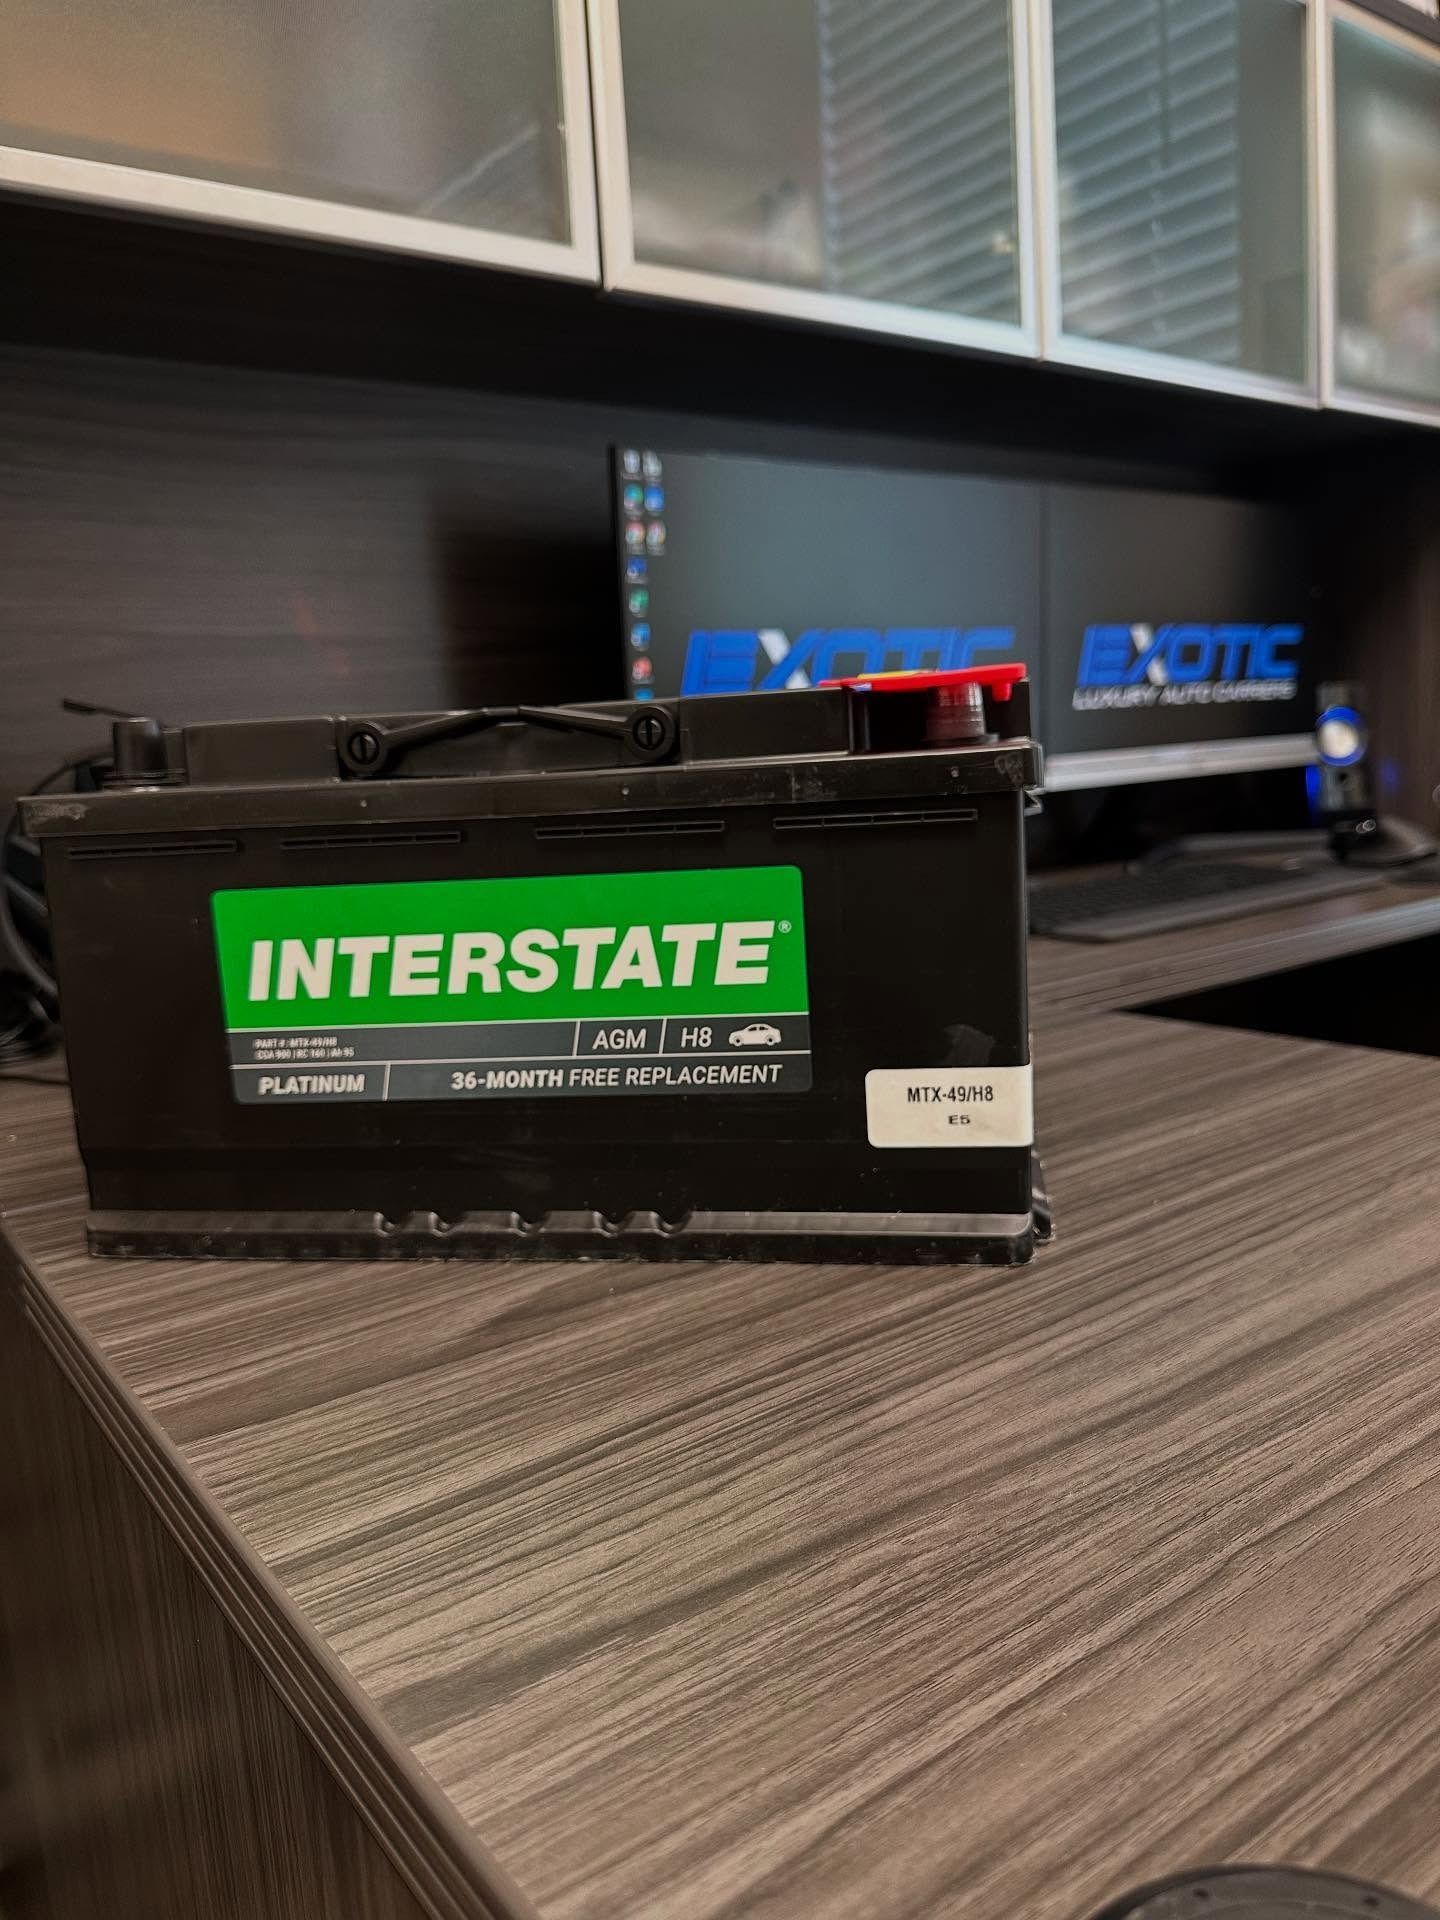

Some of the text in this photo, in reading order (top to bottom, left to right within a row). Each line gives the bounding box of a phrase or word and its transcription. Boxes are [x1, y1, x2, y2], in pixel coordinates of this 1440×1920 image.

[1076, 623, 1303, 687] EXOTIC
[592, 1028, 647, 1050] AGM
[680, 1026, 713, 1048] H8
[258, 1074, 366, 1096] PLATINUM
[451, 1064, 783, 1091] 36-MONTH FREE REPLACEMENT
[907, 1085, 995, 1103] MTX-49/H8
[948, 1114, 972, 1125] E5
